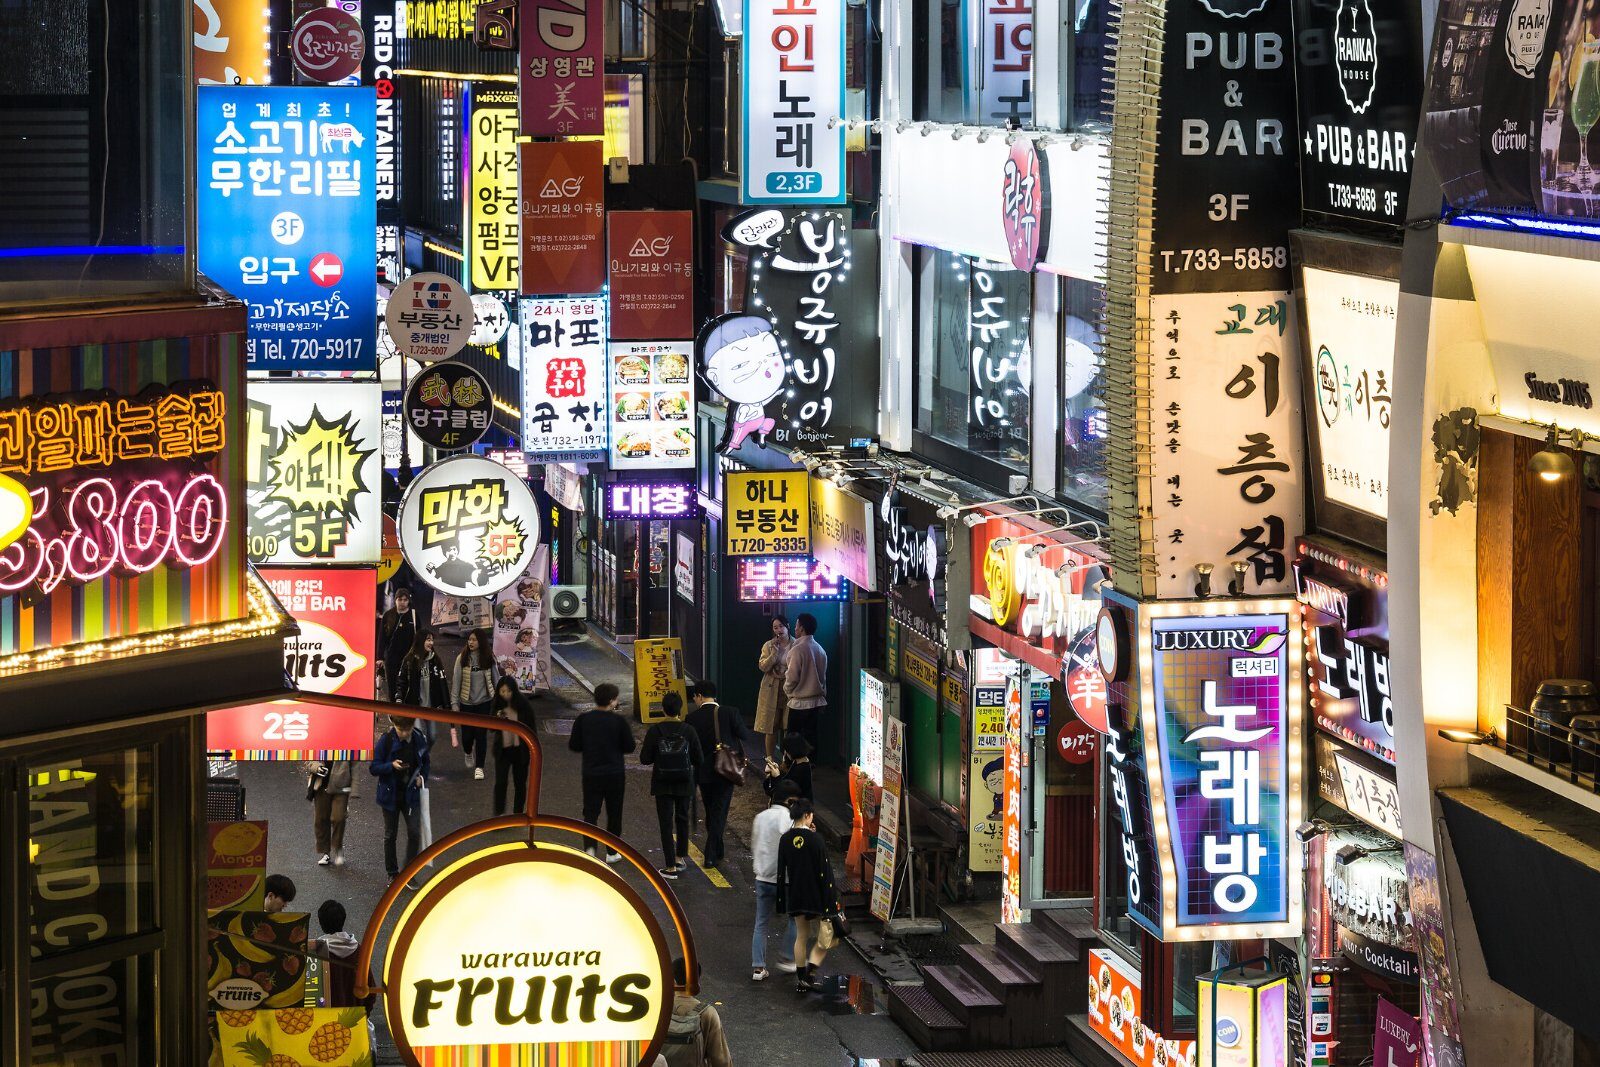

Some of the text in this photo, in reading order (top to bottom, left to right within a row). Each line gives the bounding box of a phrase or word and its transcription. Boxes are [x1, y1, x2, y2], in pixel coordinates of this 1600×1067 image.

[374, 15, 393, 63] RED
[1186, 32, 1283, 70] PUB
[1338, 37, 1374, 62] RANKA
[530, 57, 595, 78] 상영관
[1343, 69, 1370, 80] HOUSE
[547, 82, 579, 120] 美
[1224, 80, 1243, 107] &
[212, 120, 318, 157] 소고기
[557, 122, 573, 132] 3F
[1181, 119, 1283, 156] BAR
[1503, 118, 1518, 132] Jose
[1316, 124, 1353, 166] PUB
[1366, 129, 1408, 173] BAR
[1492, 129, 1527, 155] Cuervo
[209, 159, 361, 198] 무한리필
[776, 174, 815, 192] 2,3F
[522, 201, 603, 217] 오니기리와 이규동
[1208, 193, 1250, 221] 3F
[1328, 183, 1398, 215] T.733-5858 3F
[276, 218, 300, 238] 3F
[239, 256, 299, 285] 입구
[611, 260, 692, 277] 오니기리와 이규동
[1160, 246, 1287, 273] T.733-5858
[398, 312, 462, 330] 부동산
[534, 304, 595, 316] 24시 영업
[772, 219, 845, 428] 봉쥬비어
[1215, 300, 1287, 337] 교대
[410, 333, 450, 344] 중개법인
[529, 318, 600, 348] 마포
[1165, 310, 1181, 380] 추억으로
[261, 339, 286, 360] Tel.
[291, 338, 363, 360] 720-5917
[409, 345, 448, 355] T.723-9007
[1525, 372, 1561, 403] Since
[411, 408, 487, 429] 당구클럽
[532, 401, 603, 433] 곱창
[1165, 402, 1182, 453] 손맛을
[441, 432, 460, 445] 4F
[552, 435, 601, 445] 732-1197
[1216, 352, 1290, 586] 이층집
[612, 486, 690, 515] 대창
[746, 480, 788, 503] 하나
[1167, 475, 1183, 508] 내는
[420, 480, 507, 547] 만화
[736, 509, 799, 533] 부동산
[295, 515, 343, 553] 5F
[488, 534, 517, 557] 5F
[731, 537, 807, 553] T.720-3335
[295, 580, 322, 596] 없던
[744, 560, 840, 597] 부동산
[311, 596, 346, 611] BAR
[1293, 564, 1348, 631] Luxury
[1158, 629, 1254, 651] LUXURY
[649, 654, 672, 691] 부동산
[1235, 660, 1276, 675] 럭셔리
[1071, 673, 1108, 709] 羊
[263, 711, 309, 741] 2층
[1180, 680, 1276, 913] 노래방
[461, 951, 601, 969] warawara
[1365, 946, 1410, 976] Cocktail
[216, 989, 263, 1002] Fruits
[412, 973, 651, 1028] Fruits
[1217, 1026, 1236, 1039] COIN
[1380, 1015, 1412, 1046] LUXERY
